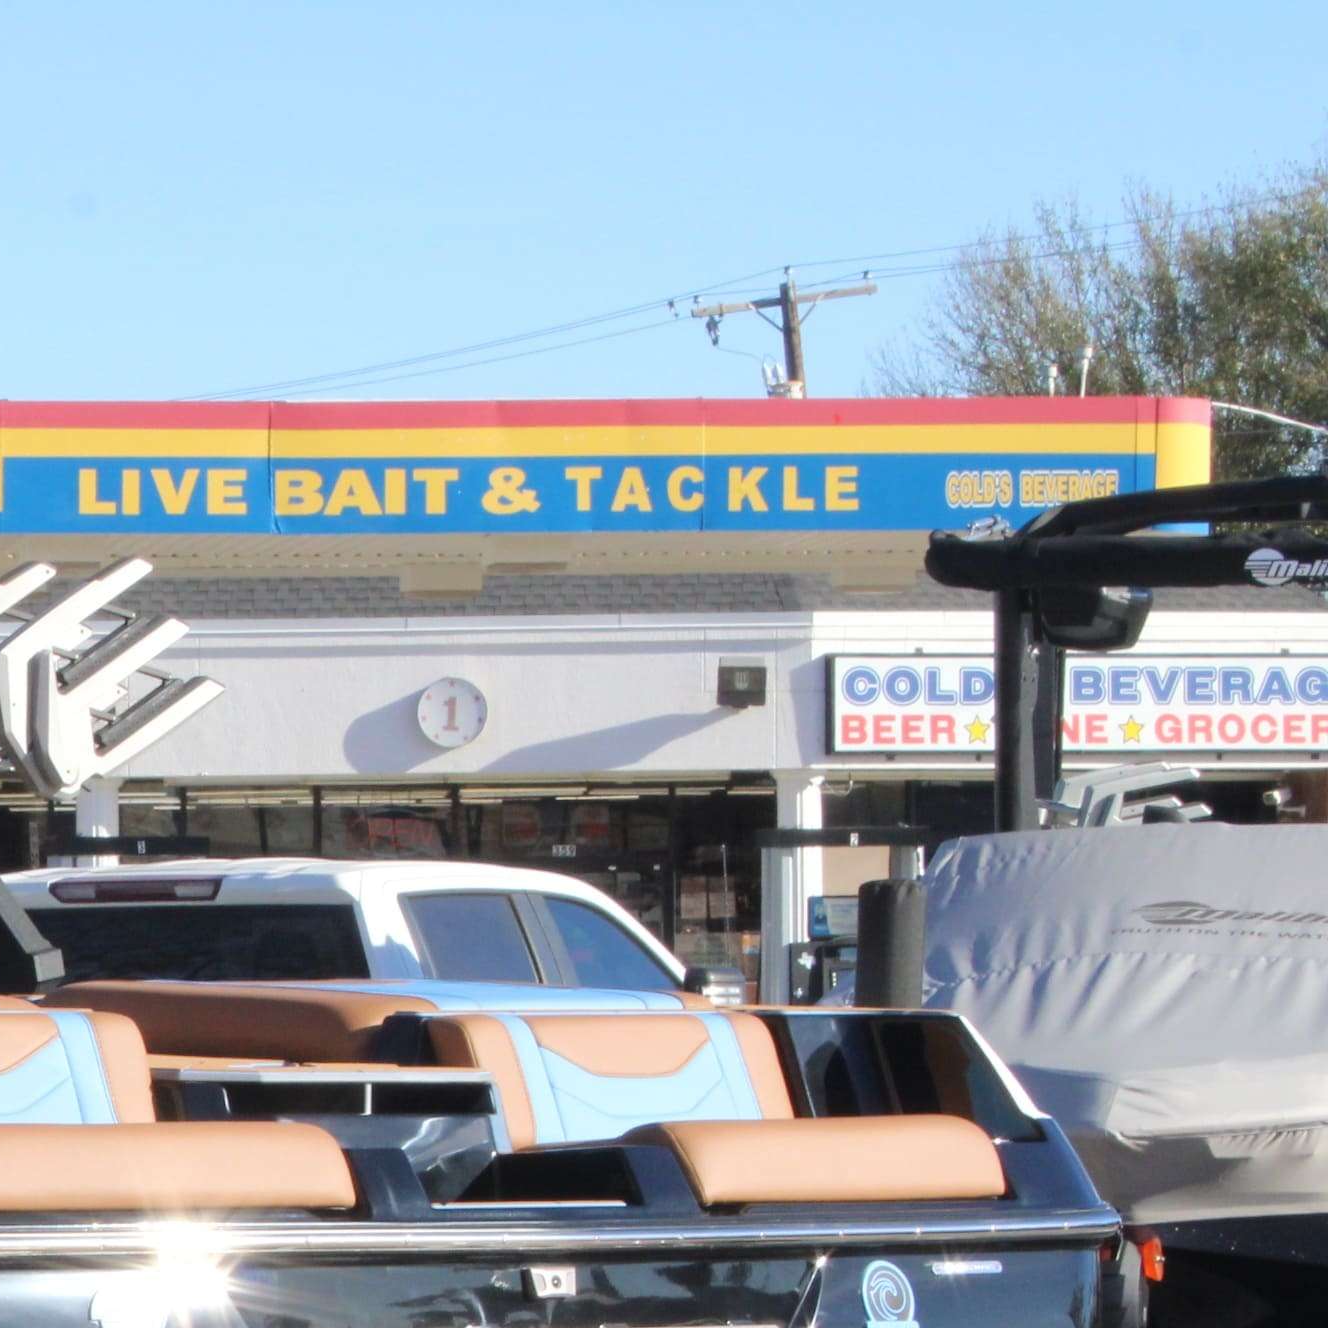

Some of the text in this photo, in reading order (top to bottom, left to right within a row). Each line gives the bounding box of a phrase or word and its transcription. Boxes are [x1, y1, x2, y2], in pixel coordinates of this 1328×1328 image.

[78, 466, 861, 516] LIVE BAIT & TACKLE
[946, 469, 1119, 508] COLD'S BEVERAGE
[842, 714, 956, 746] BEER
[1154, 714, 1328, 745] GROCER
[1176, 908, 1328, 923] Malib
